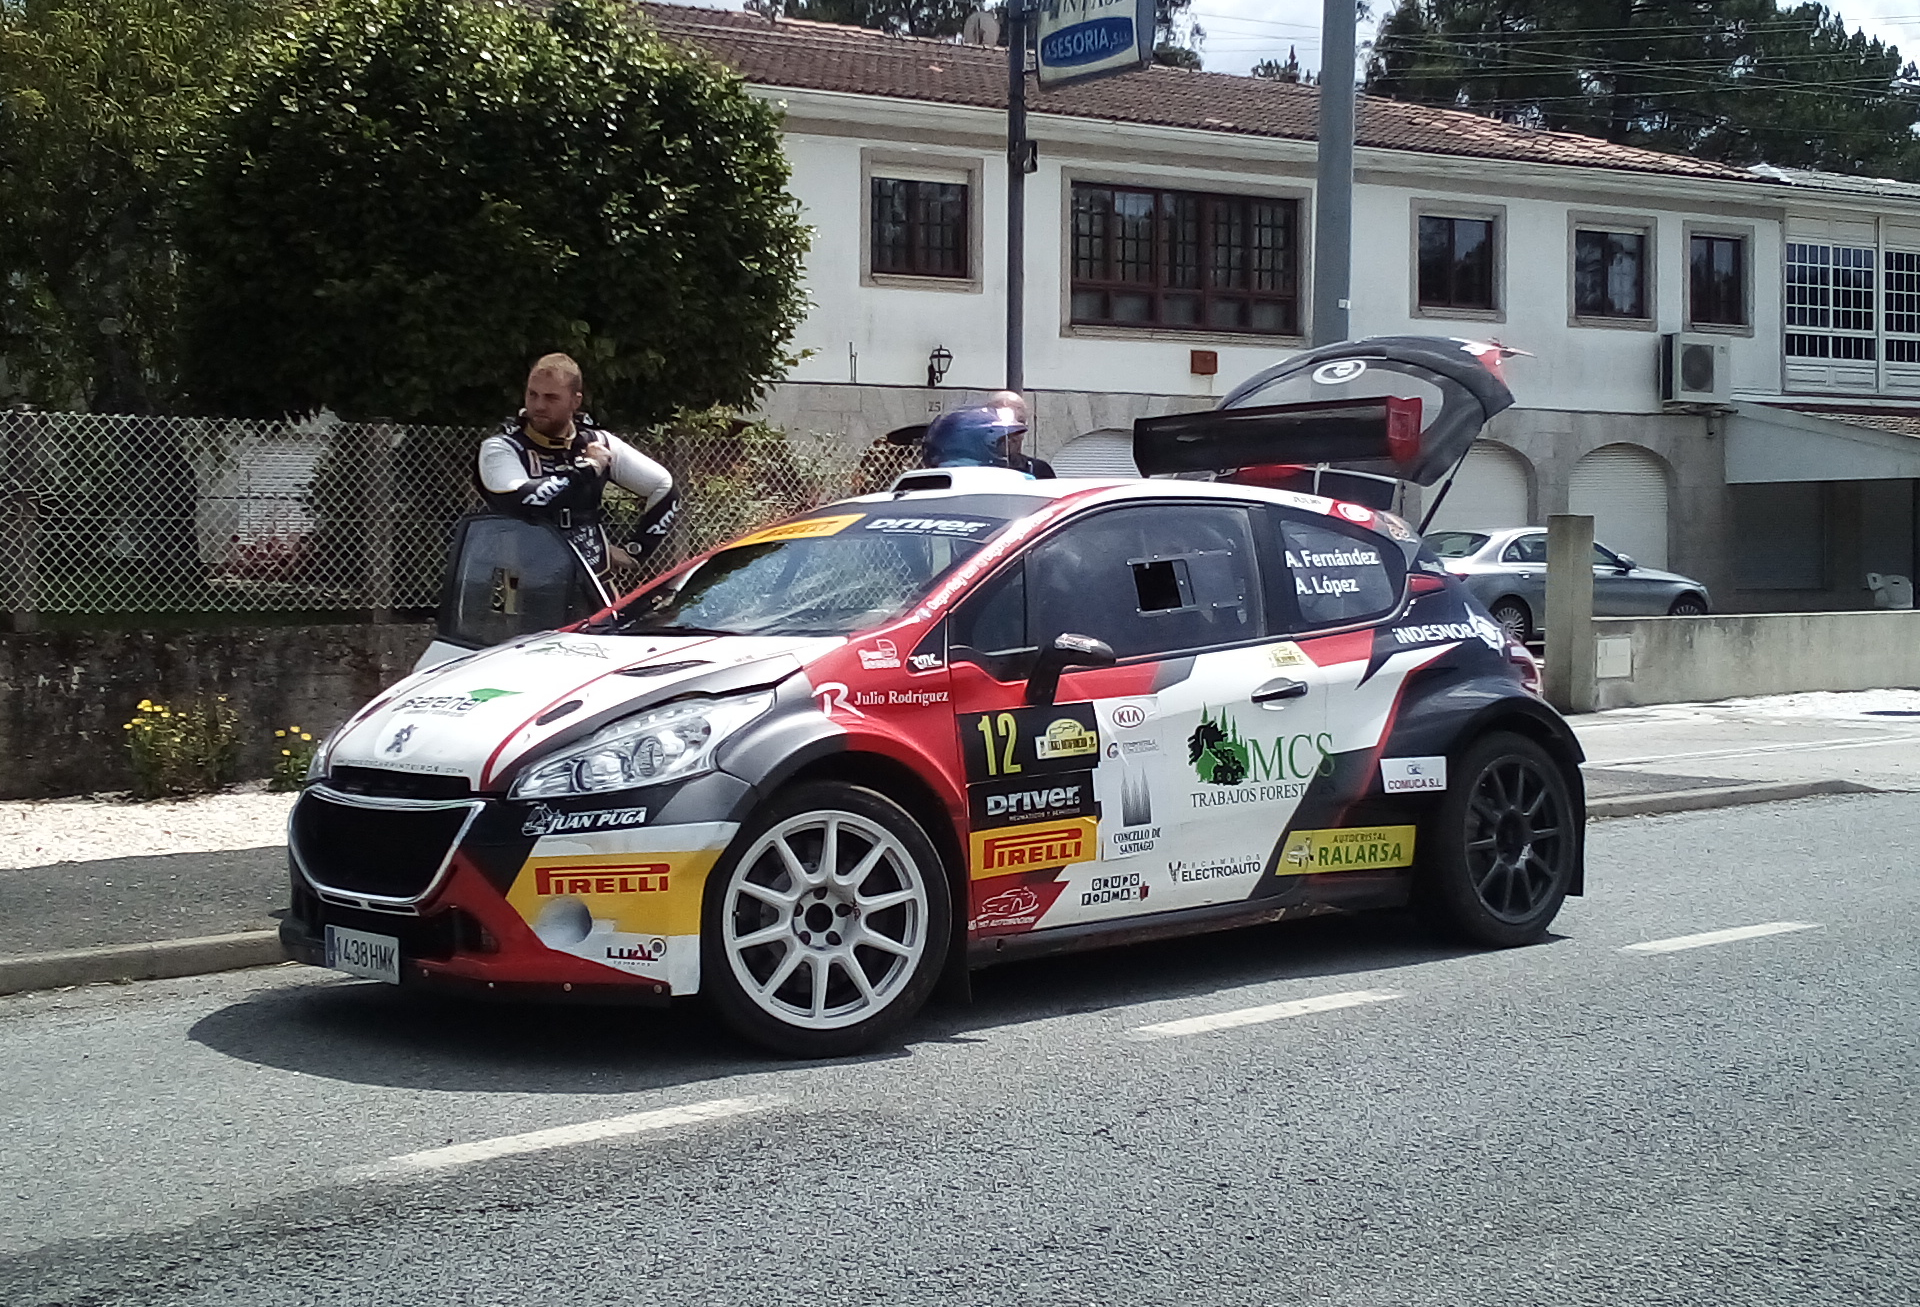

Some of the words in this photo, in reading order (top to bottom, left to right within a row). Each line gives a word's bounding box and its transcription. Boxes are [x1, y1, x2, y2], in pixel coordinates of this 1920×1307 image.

[1301, 548, 1380, 568] Fernández
[1312, 575, 1360, 598] López
[854, 691, 885, 706] Julio
[888, 689, 949, 706] Rodríguez
[1117, 711, 1141, 723] KIA
[977, 712, 1022, 776] 12
[1248, 732, 1336, 783] MCS
[1388, 779, 1427, 790] COMUCA
[1190, 788, 1257, 808] TRABAJOS
[548, 814, 595, 833] JUAN
[596, 810, 647, 827] PUGA
[1114, 828, 1150, 844] CONCELLO
[1152, 827, 1161, 838] DE
[1333, 832, 1387, 844] AUTOCRISTAL
[983, 828, 1082, 870] PIRELLI
[1120, 840, 1154, 855] SANTIAGO
[1318, 842, 1403, 867] RALARSA
[535, 863, 670, 895] PIRELLI
[1181, 861, 1261, 882] ELECTROAUTO
[1091, 873, 1140, 891] GRUPO
